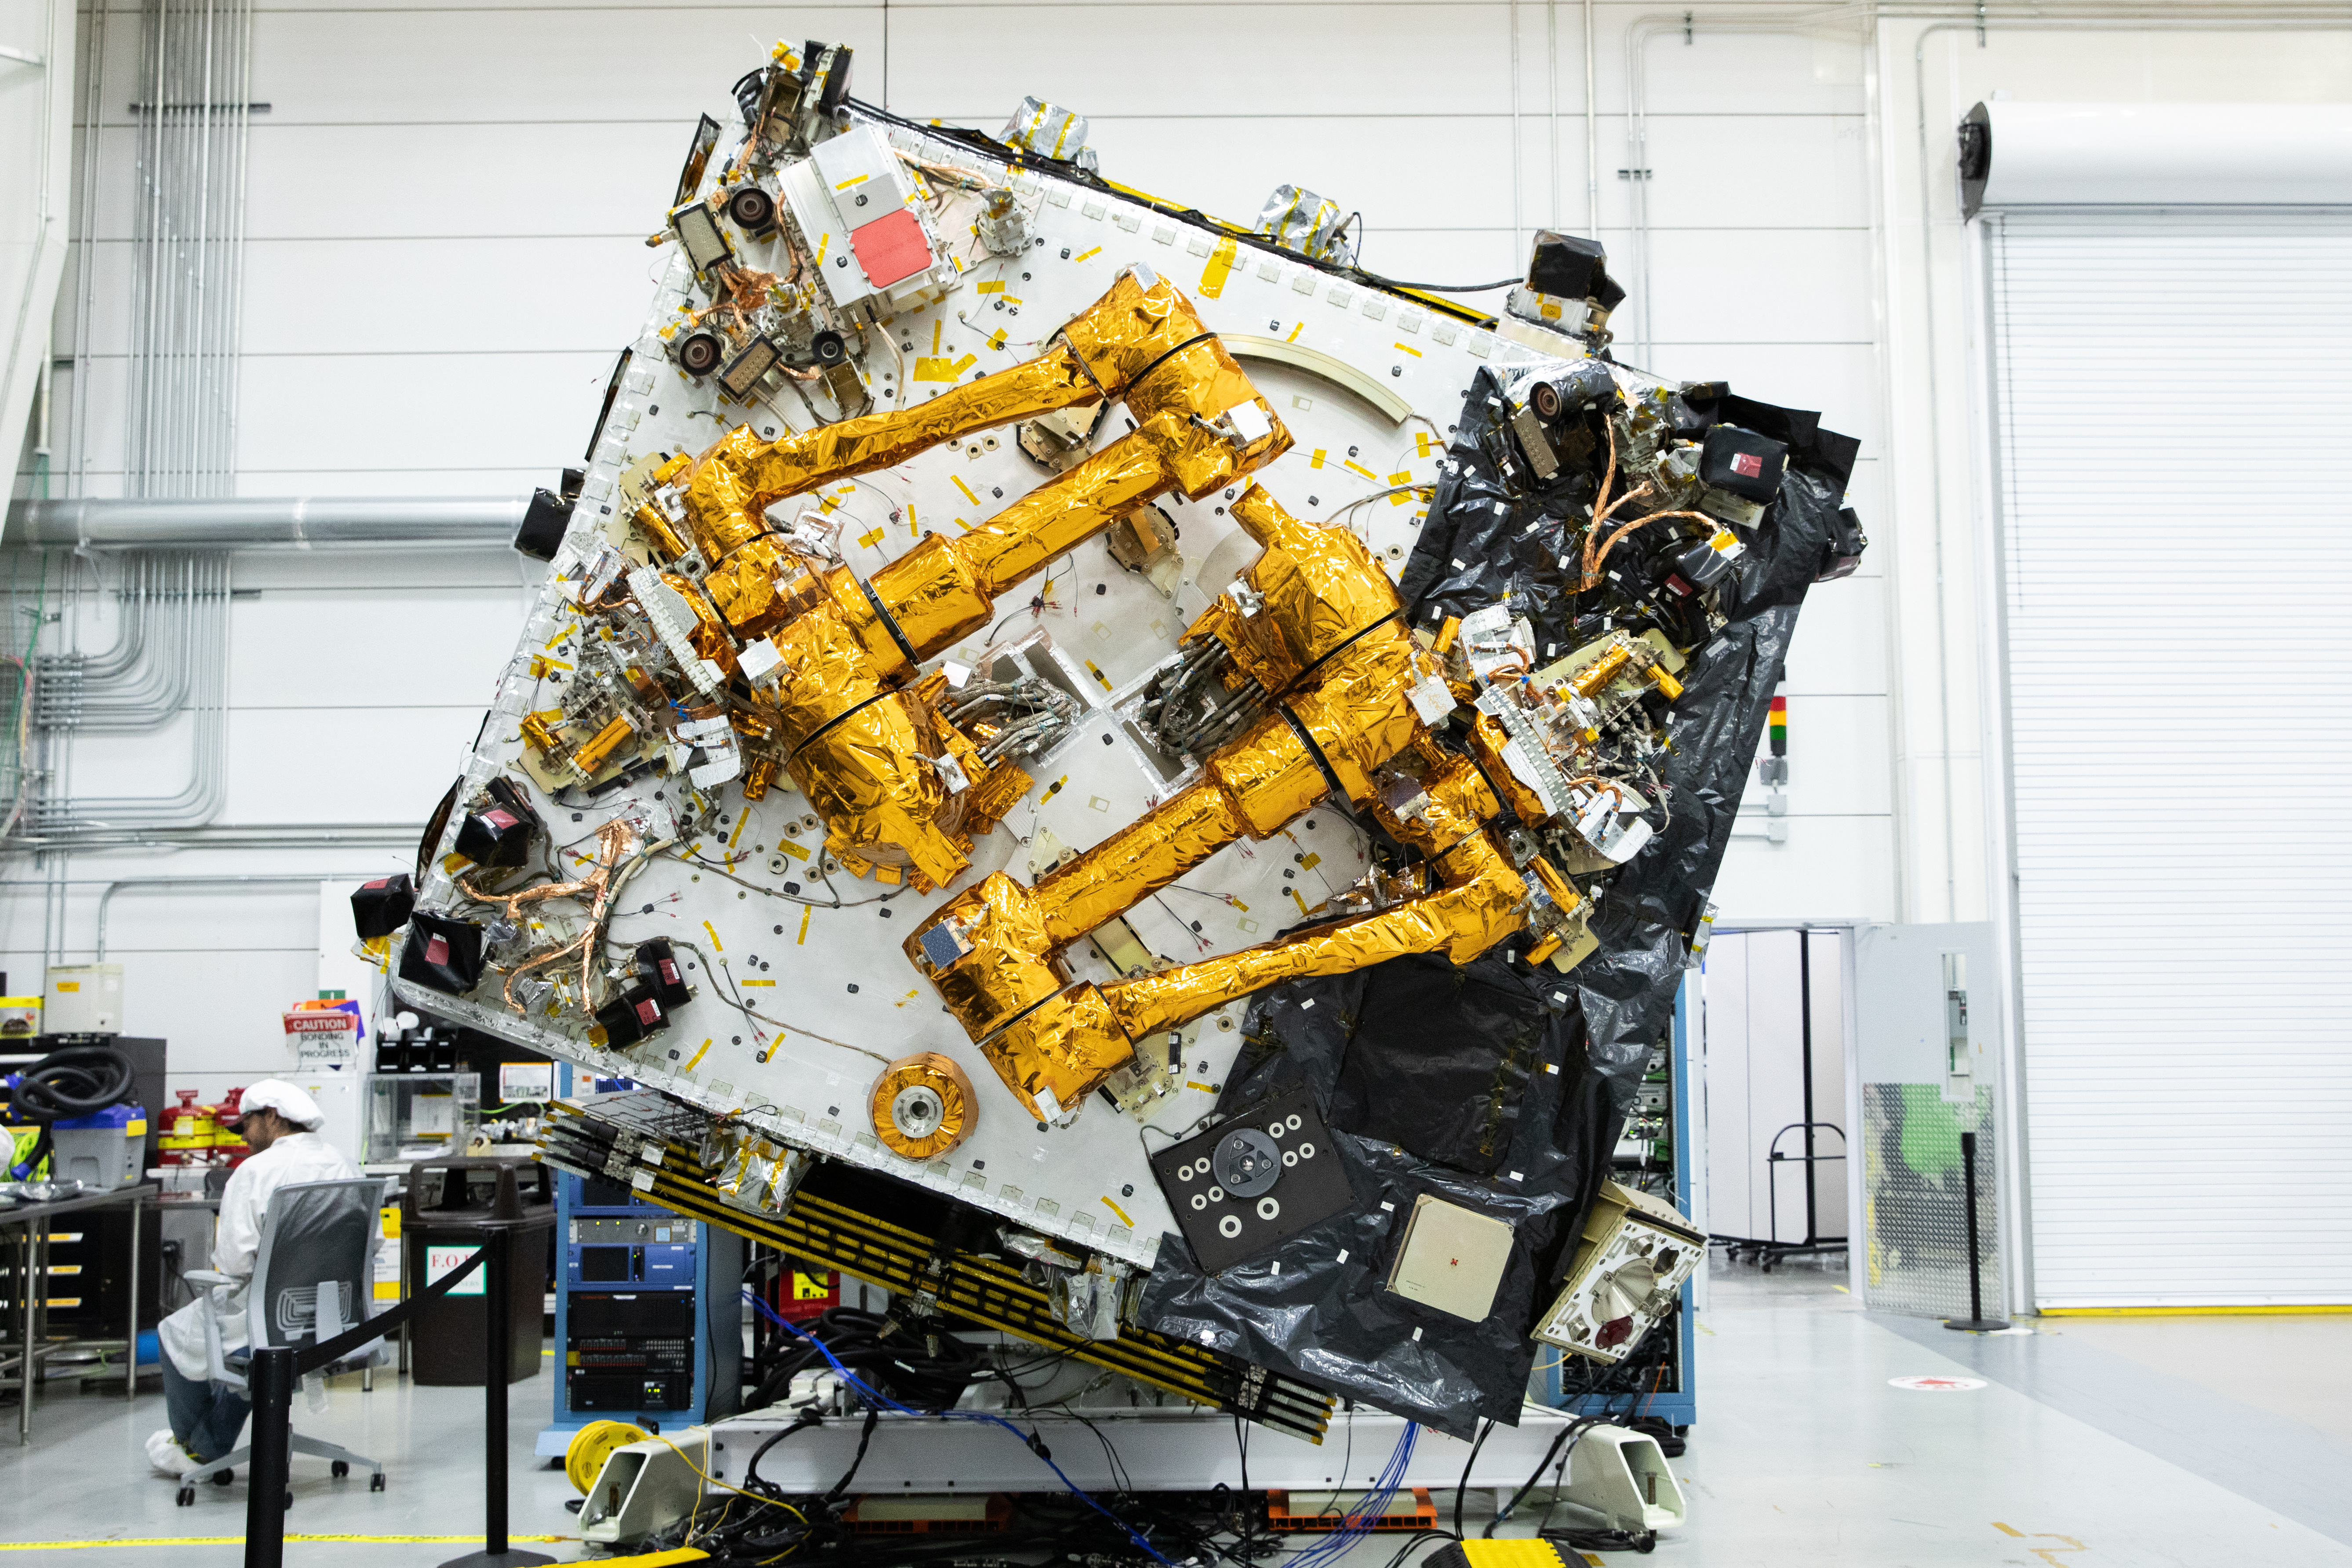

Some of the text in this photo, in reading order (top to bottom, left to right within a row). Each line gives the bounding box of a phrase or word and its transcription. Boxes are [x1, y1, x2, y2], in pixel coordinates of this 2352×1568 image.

[293, 1019, 347, 1031] CAUTION
[301, 1032, 344, 1041] BONDING
[301, 1049, 350, 1057] PROGRESS
